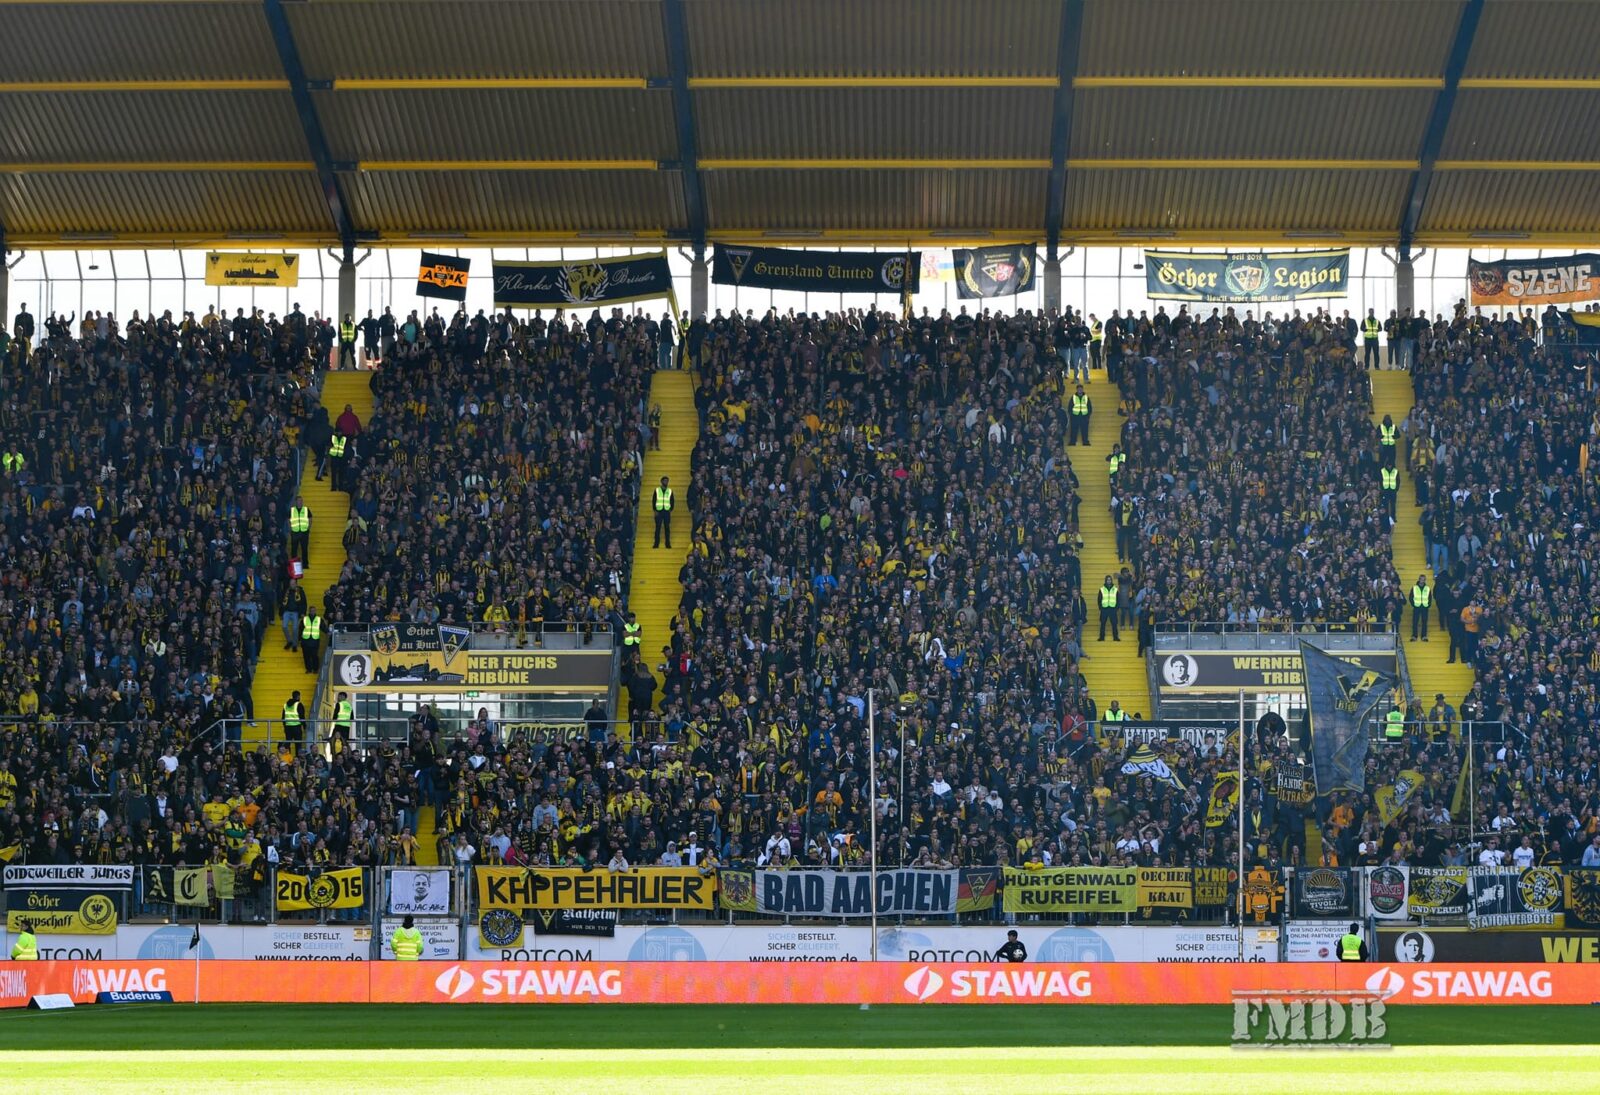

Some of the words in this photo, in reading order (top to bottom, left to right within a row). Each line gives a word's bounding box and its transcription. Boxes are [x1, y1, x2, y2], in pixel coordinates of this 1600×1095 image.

[754, 262, 823, 278] Grenzland
[828, 265, 873, 279] United
[1158, 262, 1217, 289] Öcher
[1274, 267, 1341, 289] Legion
[1507, 264, 1591, 297] SZENE
[406, 625, 435, 637] Öcher
[468, 656, 499, 669] NER
[503, 656, 558, 669] FUCHS
[1233, 657, 1303, 669] WERNER
[462, 670, 529, 684] RIBÜNE
[1262, 671, 1304, 684] TRIB
[5, 867, 85, 880] OIDTWEILER
[91, 866, 131, 880] JUNGS
[1141, 870, 1192, 882] OECHER
[1195, 868, 1227, 881] PYRO
[1433, 868, 1464, 877] STADT
[1467, 865, 1497, 877] GEGEN
[1499, 865, 1521, 876] ALLE
[150, 870, 168, 898] A
[1005, 872, 1137, 886] HÜRTGENWALD
[278, 880, 303, 900] 20
[343, 877, 362, 898] 15
[764, 873, 824, 912] BAD
[831, 872, 952, 913] AACHEN
[1195, 887, 1227, 899] KEIN
[28, 892, 60, 909] Öcher
[1021, 890, 1123, 904] RUREIFEL
[1148, 891, 1185, 903] KRAU
[1310, 900, 1337, 909] TIVOLI
[1411, 905, 1429, 913] UND
[1431, 905, 1464, 914] VEREIN
[273, 932, 302, 940] SICHER
[303, 932, 342, 940] BESTELLT.
[798, 933, 837, 941] BESTELLT.
[1176, 943, 1205, 951] SICHER
[38, 949, 102, 960] TCOM
[255, 953, 363, 961] wwwrotcomde
[501, 950, 592, 961] ROTCOM
[749, 953, 858, 962] wwwrotcomde
[909, 950, 1000, 962] ROTCOM
[80, 968, 166, 993] STAWAG
[482, 970, 622, 996] STAWAG
[951, 970, 1092, 997] STAWAG
[1413, 970, 1552, 997] STAWAG
[110, 991, 161, 1001] Buderus
